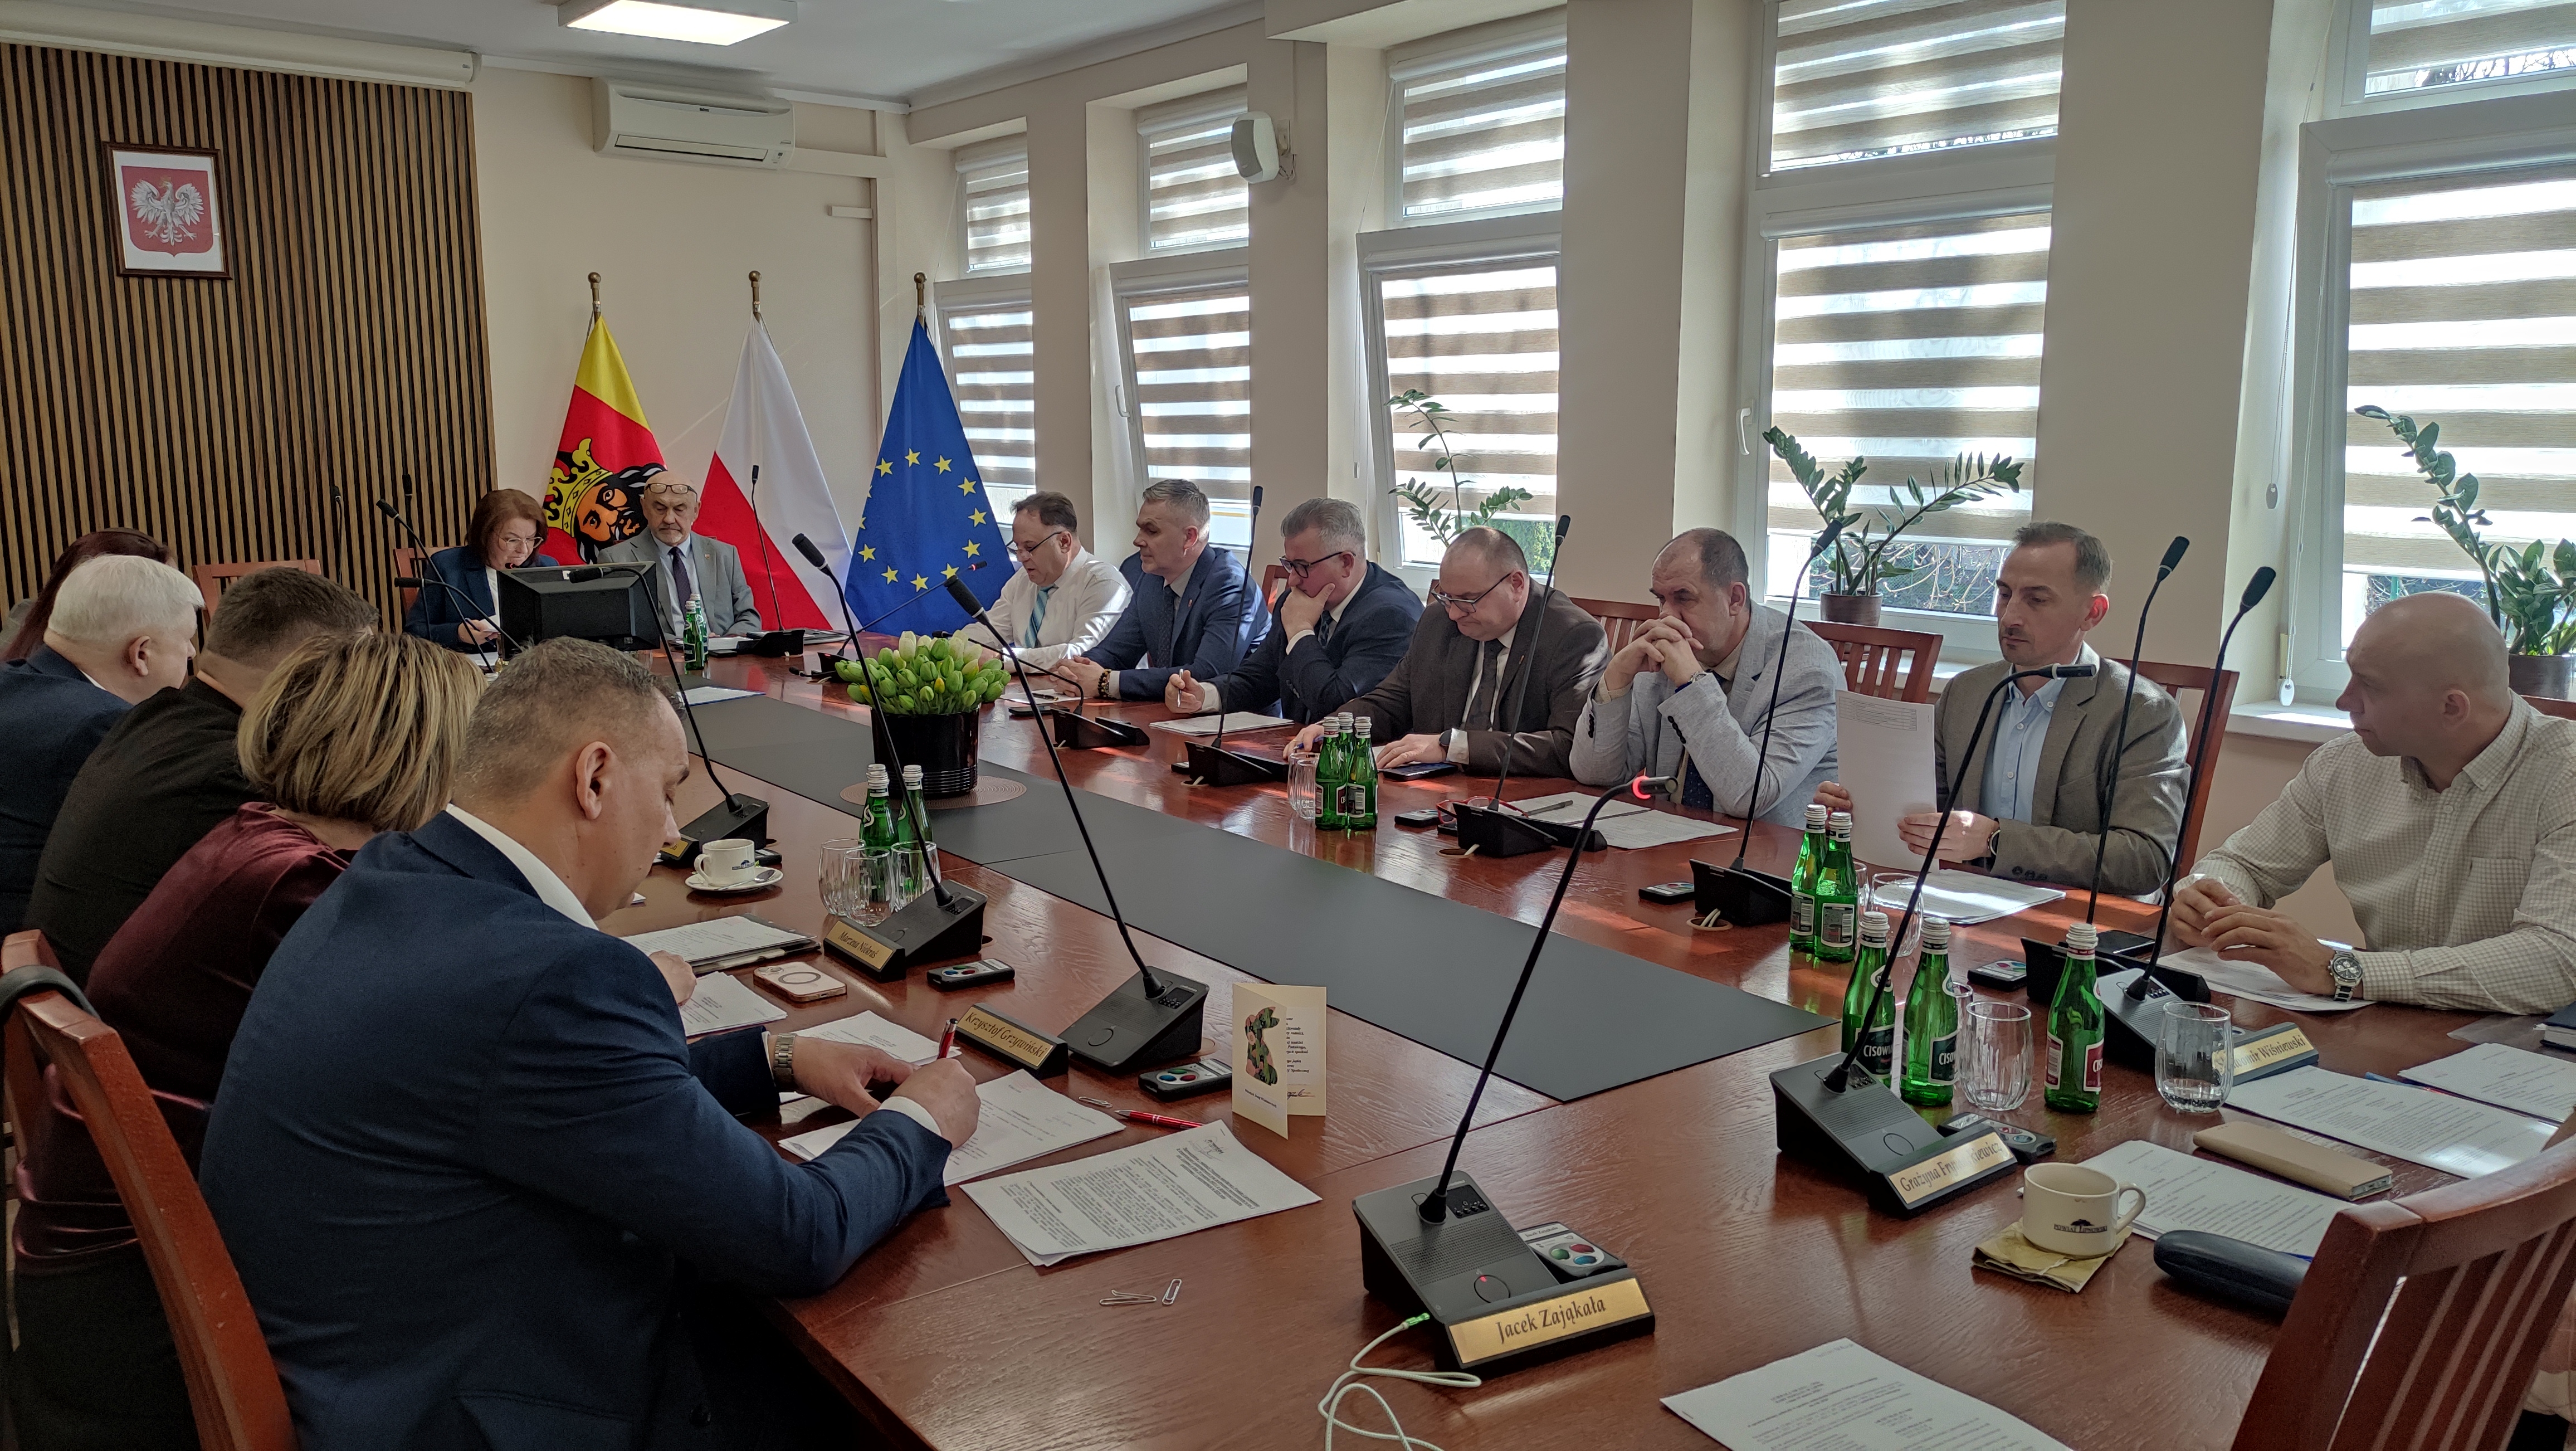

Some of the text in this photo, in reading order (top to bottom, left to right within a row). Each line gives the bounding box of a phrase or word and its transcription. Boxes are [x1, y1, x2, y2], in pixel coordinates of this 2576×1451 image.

[965, 1011, 1047, 1058] Krzysztof Grzywiński
[2257, 1035, 2306, 1059] Wiśniewski
[1900, 1168, 1941, 1191] Grażyna
[1495, 1296, 1607, 1344] Jacek Zająkała
